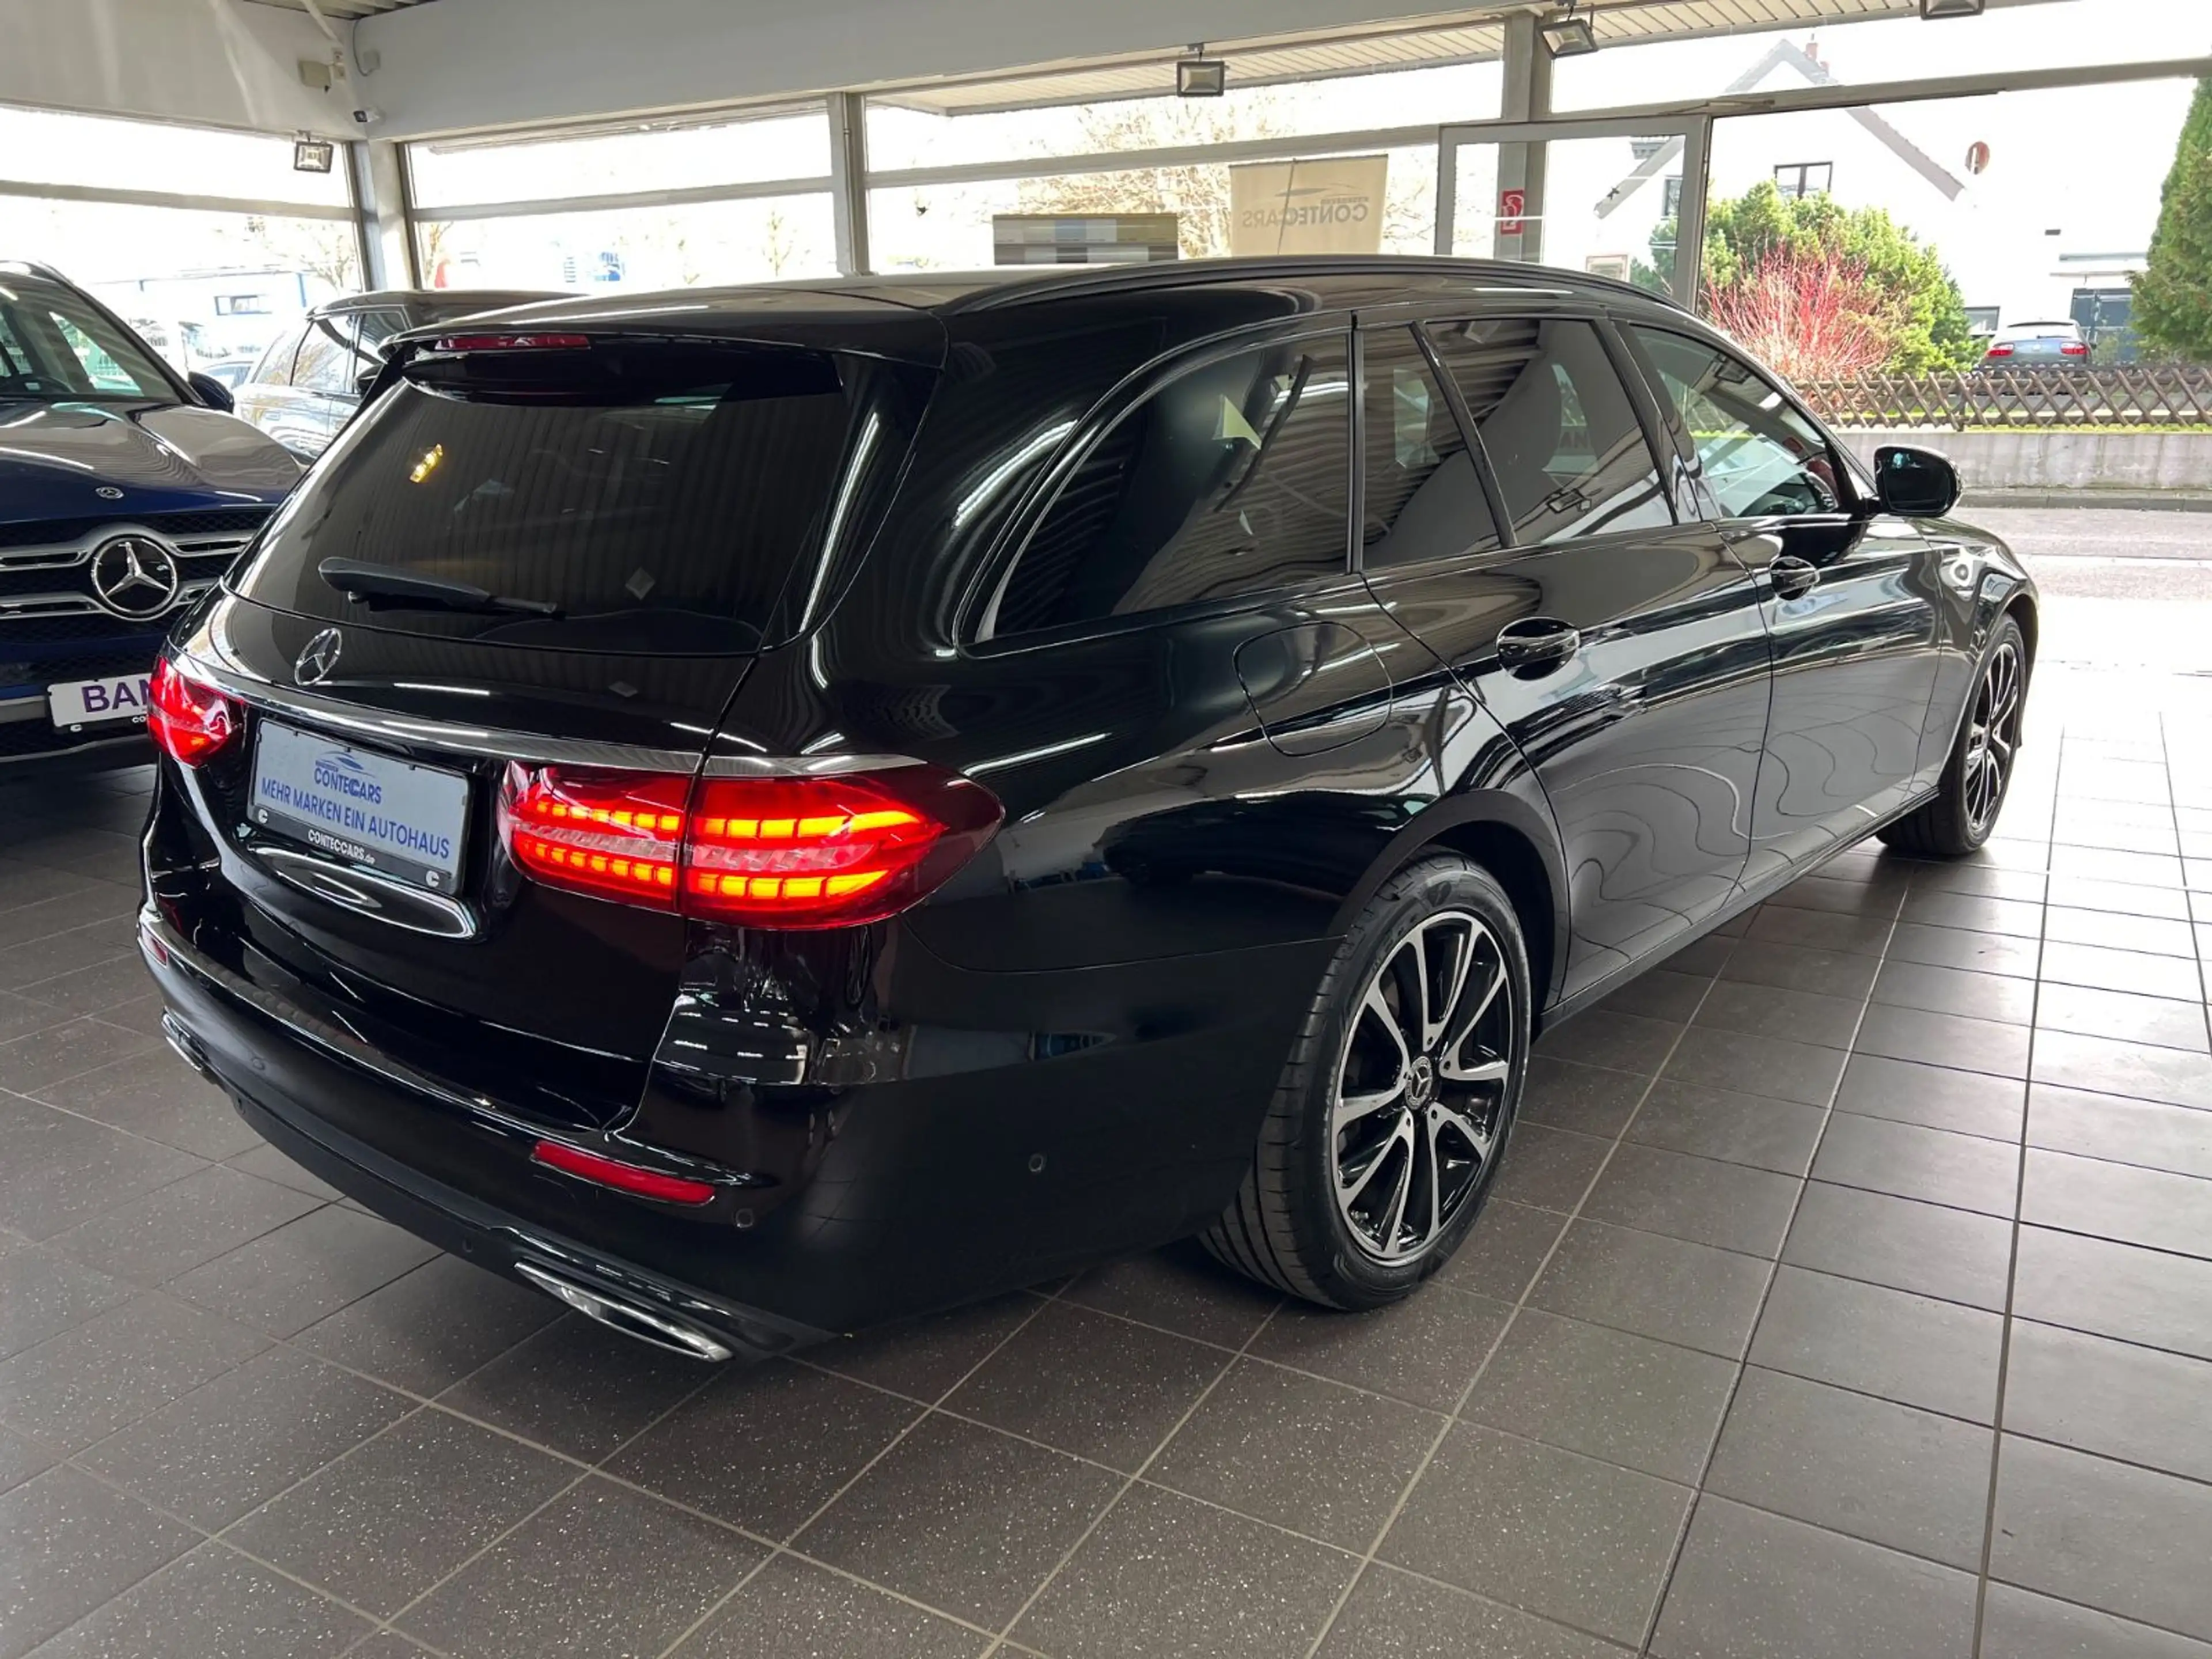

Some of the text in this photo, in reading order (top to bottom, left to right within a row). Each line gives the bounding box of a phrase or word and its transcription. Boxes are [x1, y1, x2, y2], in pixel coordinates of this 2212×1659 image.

[262, 777, 449, 859] MEHR MARKEN EIN AUTOHAUS
